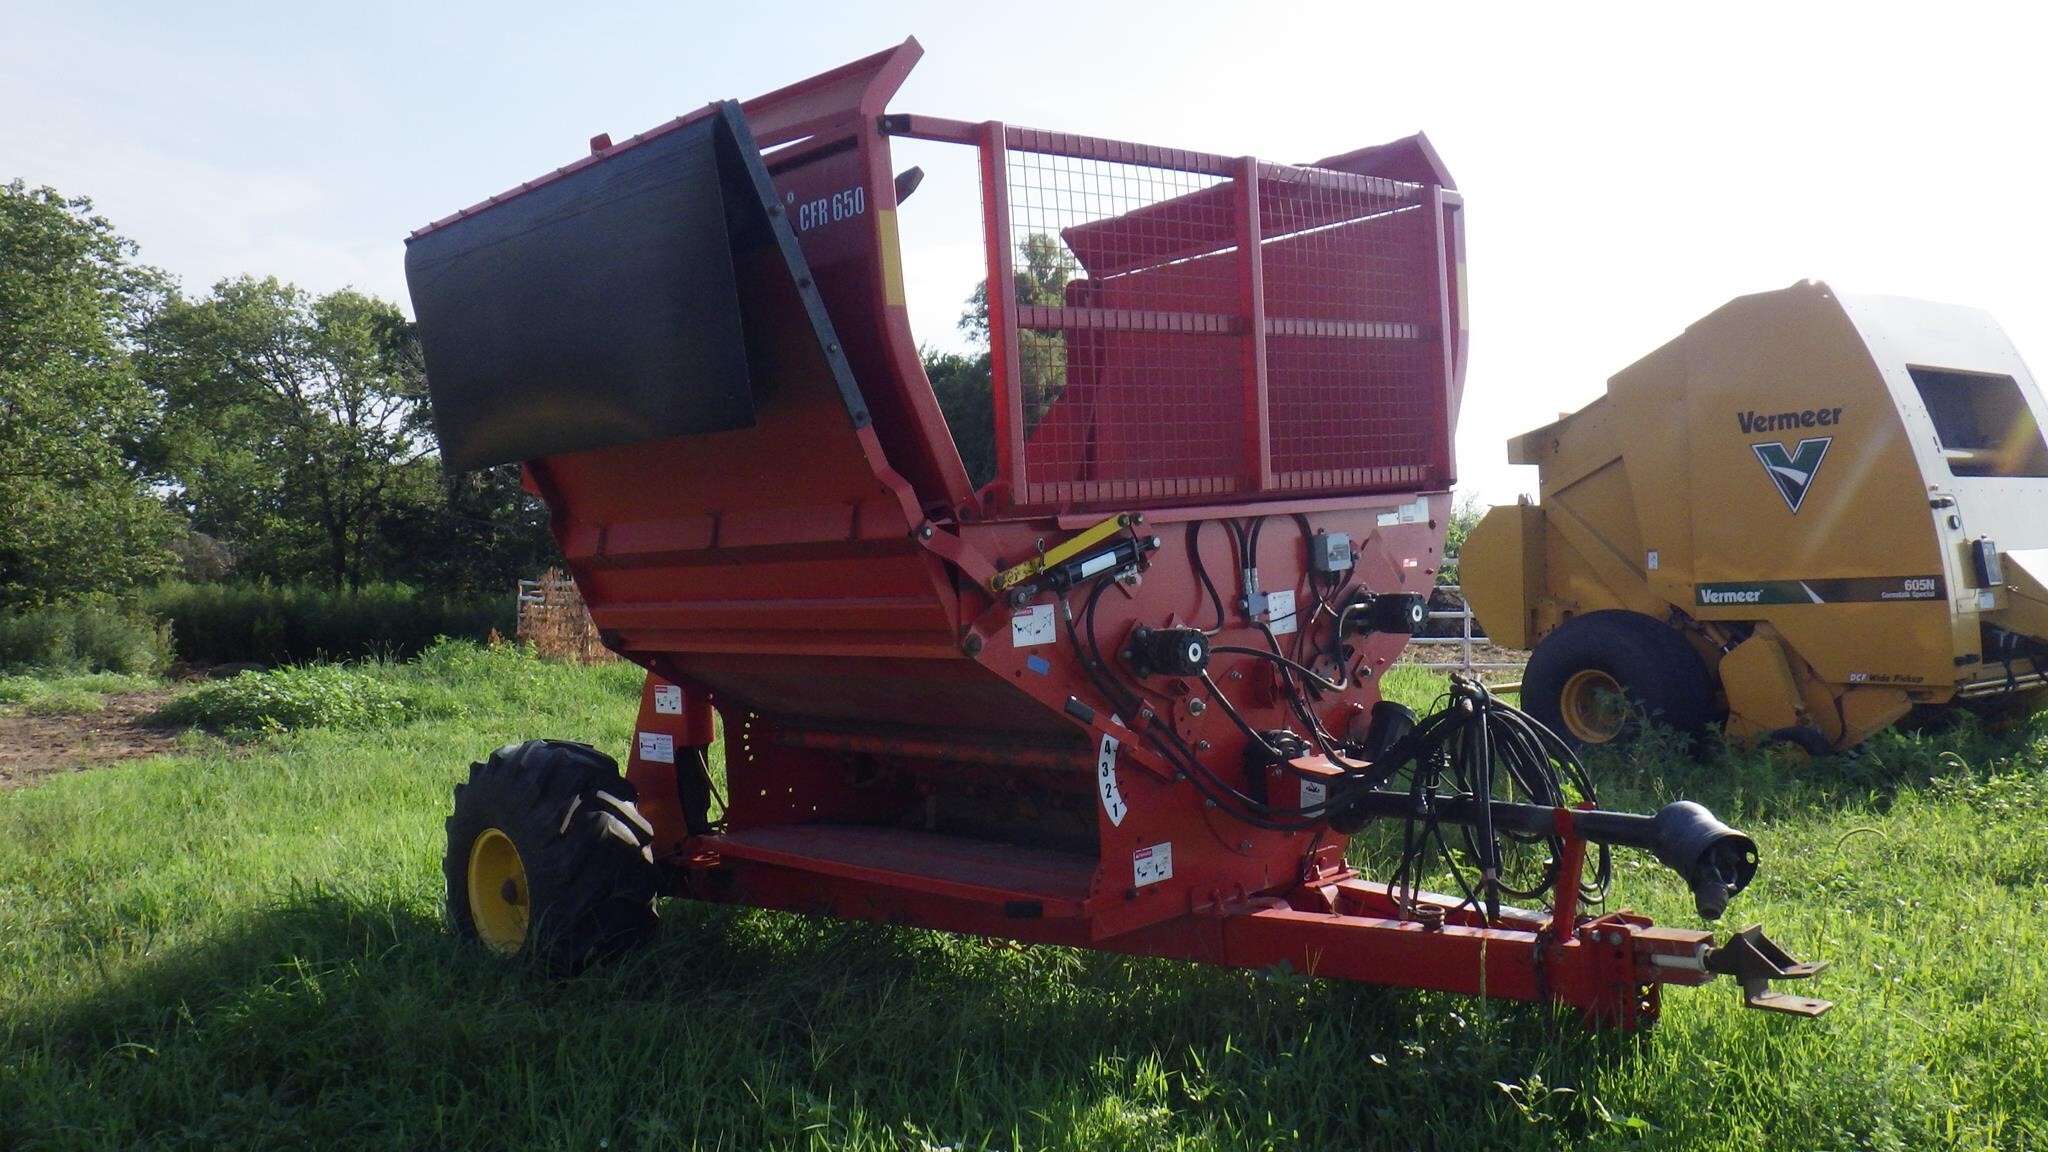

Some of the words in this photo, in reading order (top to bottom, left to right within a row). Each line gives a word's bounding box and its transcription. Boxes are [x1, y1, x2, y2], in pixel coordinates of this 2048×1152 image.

[799, 198, 828, 231] CFR
[832, 186, 865, 221] 650
[1737, 407, 1842, 434] Vermeer
[1904, 579, 1935, 591] 605N
[1700, 588, 1761, 603] Vermeer
[1104, 740, 1111, 755] 4
[1102, 762, 1109, 777] 3
[1105, 783, 1112, 798] 2
[1113, 803, 1118, 817] 1
